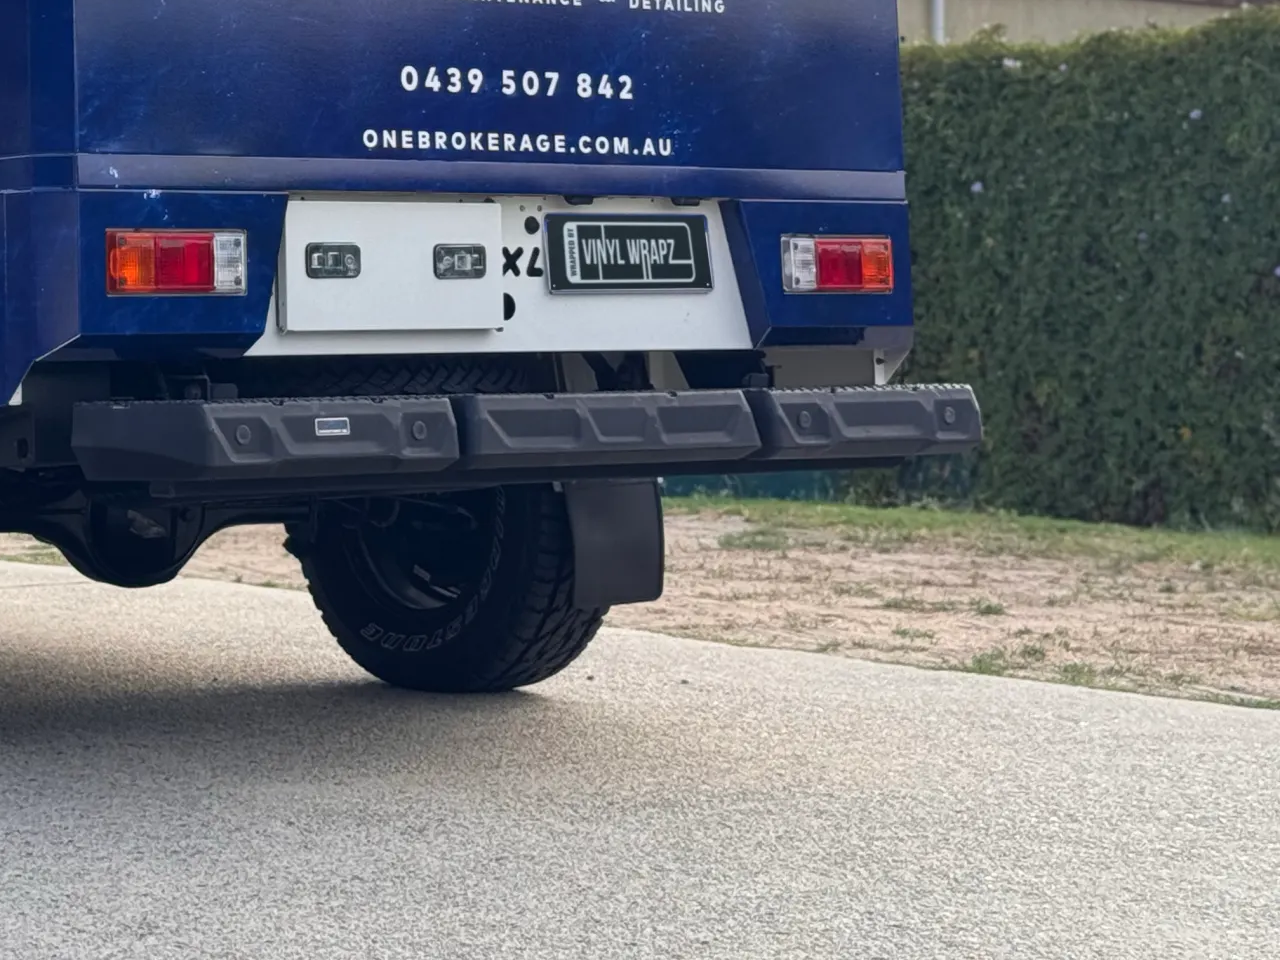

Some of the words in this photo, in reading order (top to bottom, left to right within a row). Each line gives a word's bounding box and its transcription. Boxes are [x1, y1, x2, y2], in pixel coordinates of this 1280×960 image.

[399, 65, 484, 94] 0439
[501, 69, 560, 98] 507
[575, 72, 634, 100] 842
[361, 129, 673, 158] ONEBROKERAGE.COM.AU
[581, 237, 625, 266] VINYL
[626, 238, 676, 266] WRAPZ
